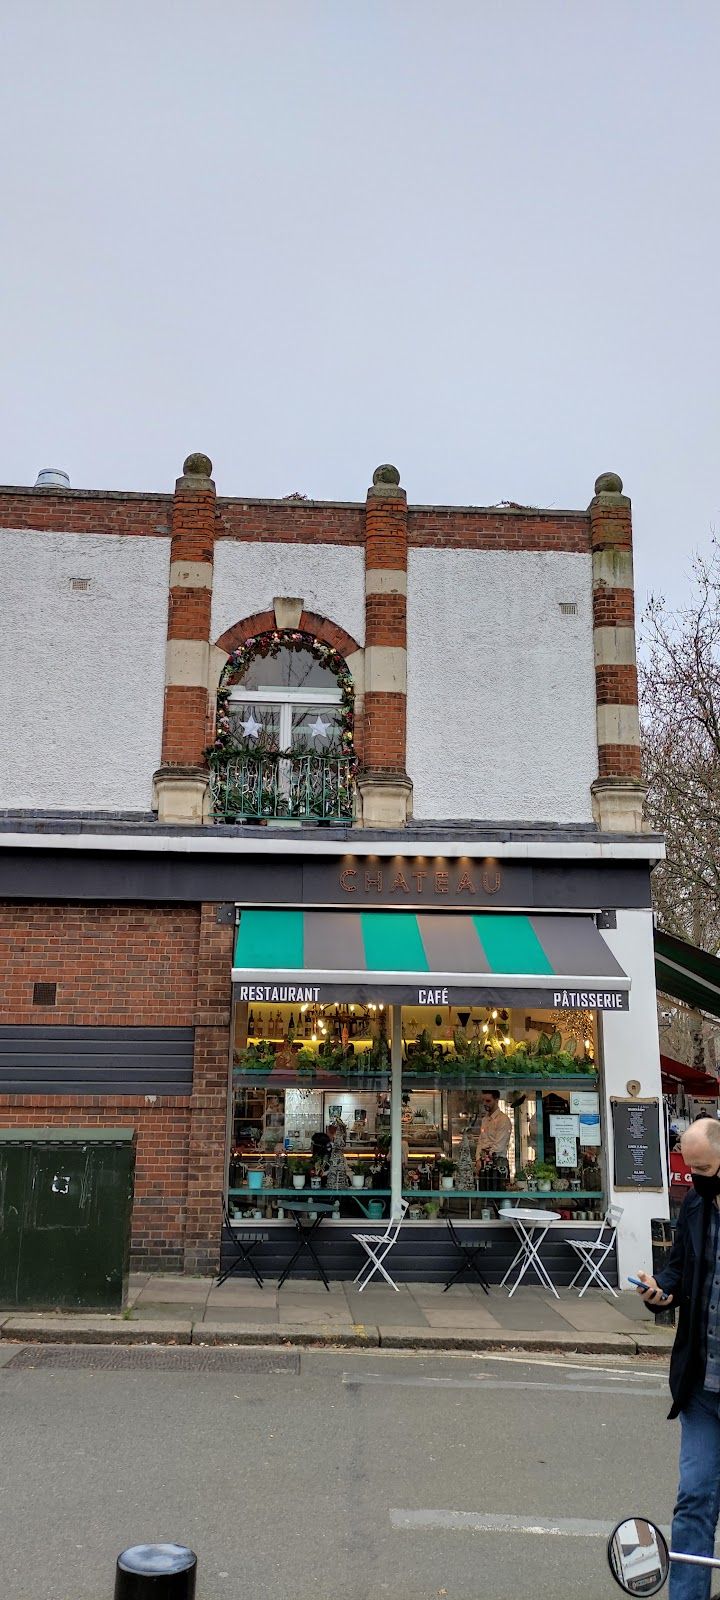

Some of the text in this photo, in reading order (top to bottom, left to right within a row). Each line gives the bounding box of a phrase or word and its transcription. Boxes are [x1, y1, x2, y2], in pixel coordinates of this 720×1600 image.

[339, 869, 502, 894] CHATEAU
[240, 986, 321, 1002] RESTAURANT
[418, 987, 449, 1005] CAFÉ
[553, 989, 623, 1008] PÂTISSERIE
